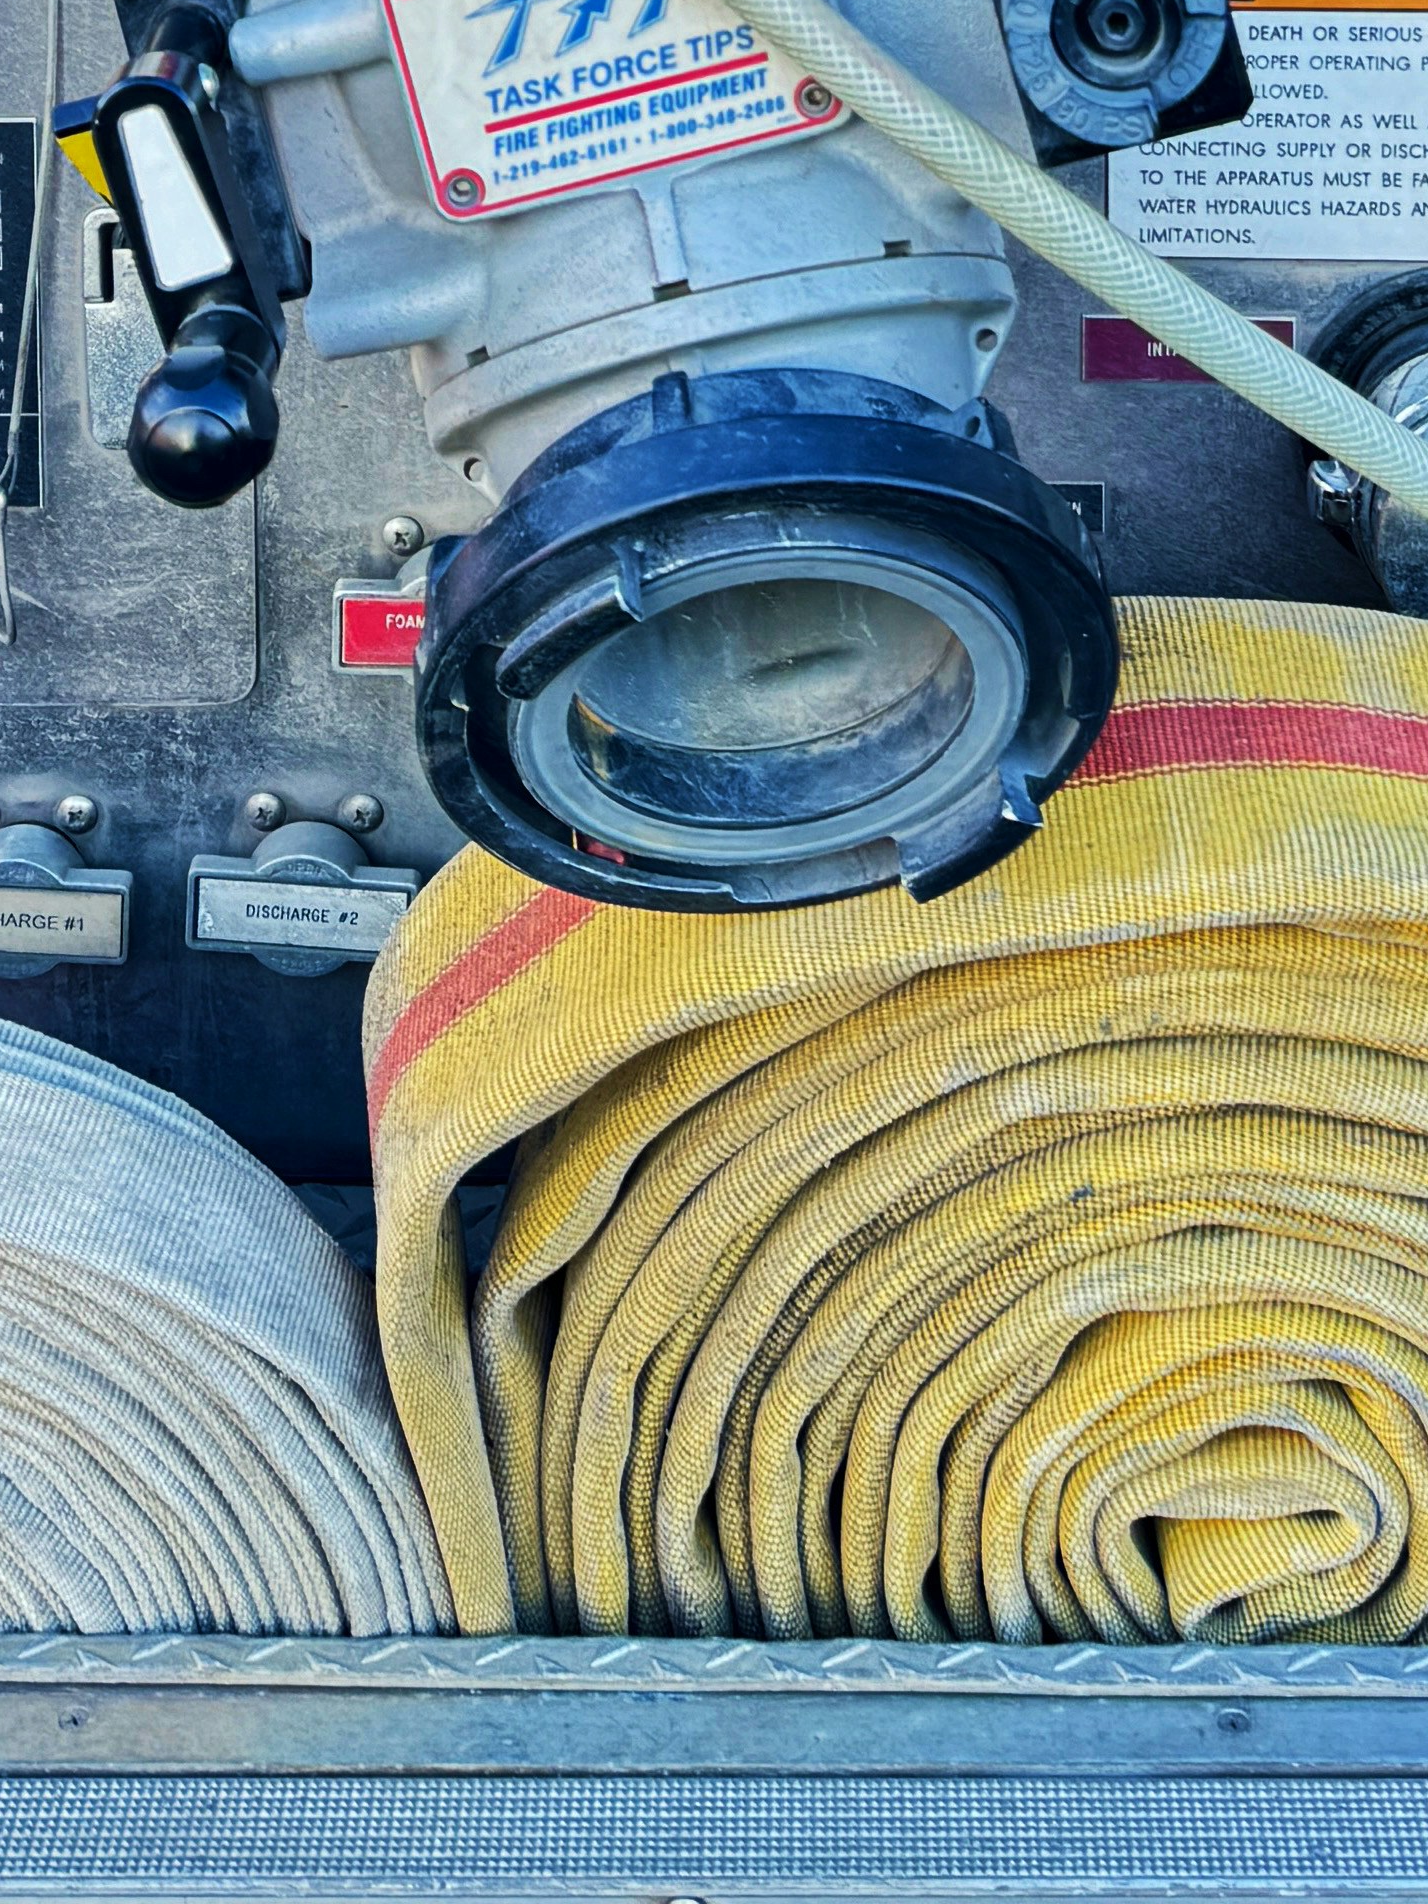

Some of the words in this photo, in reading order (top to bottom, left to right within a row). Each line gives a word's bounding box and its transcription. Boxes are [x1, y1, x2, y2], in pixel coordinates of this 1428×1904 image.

[1249, 25, 1303, 41] DEATH
[1312, 25, 1338, 41] OR
[1349, 26, 1423, 42] SERIOUS
[485, 74, 565, 114] TASK
[572, 44, 677, 93] FORCE
[685, 26, 755, 65] TIPS
[1310, 55, 1411, 71] OPERATING
[493, 128, 539, 156] FIRE
[547, 100, 642, 142] FIGHTING
[649, 68, 770, 118] EQUIPMENT
[1241, 113, 1329, 129] OPERATOR
[1341, 113, 1362, 129] AS
[1373, 114, 1418, 129] WELL
[1139, 140, 1266, 157] CONNECTING
[1277, 141, 1335, 158] SUPPLY
[1345, 142, 1371, 158] OR
[1140, 170, 1163, 185] TO
[1174, 170, 1207, 185] THE
[1216, 170, 1313, 186] APPARATUS
[1323, 171, 1371, 187] MUST
[1382, 171, 1402, 187] BE
[1139, 198, 1195, 215] WATER
[1206, 199, 1311, 216] HYDRAULICS
[1320, 200, 1401, 216] HAZARDS
[1139, 228, 1255, 244] LIMITATIONS.
[63, 913, 85, 933] #1
